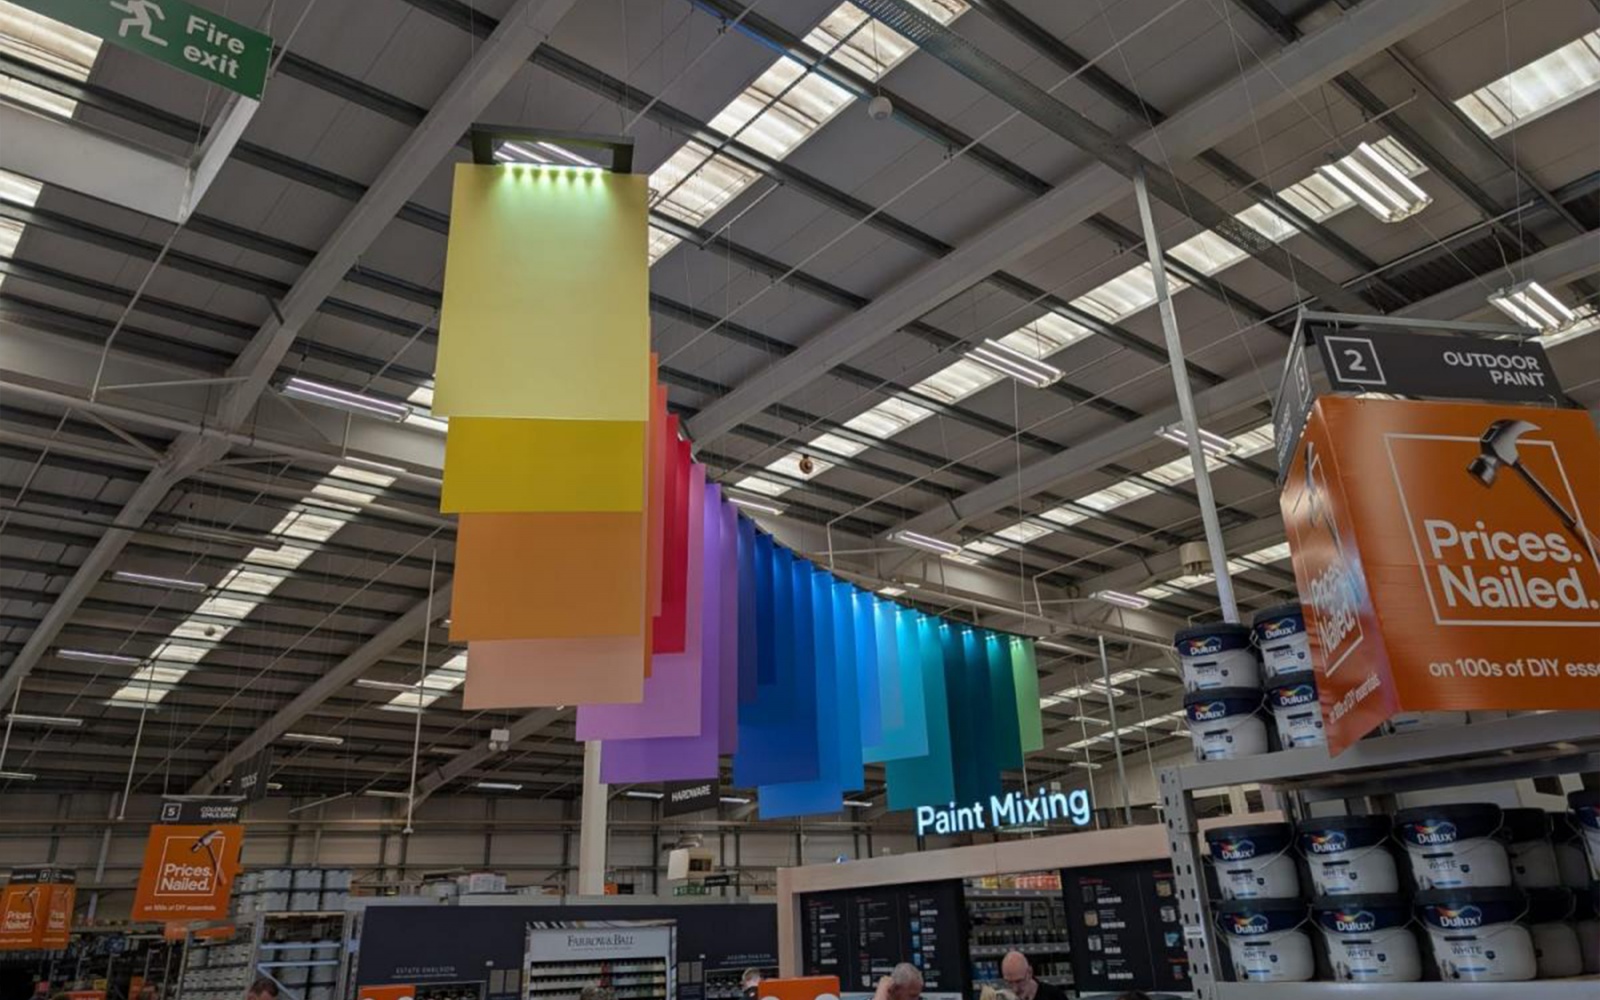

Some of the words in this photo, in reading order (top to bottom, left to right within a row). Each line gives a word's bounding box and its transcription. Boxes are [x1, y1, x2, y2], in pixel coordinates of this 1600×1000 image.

[186, 14, 245, 54] Fire
[183, 45, 240, 79] exit
[1343, 349, 1368, 371] 2
[1443, 351, 1540, 371] OUTDOOR
[1491, 370, 1545, 387] PAINT
[1423, 520, 1583, 563] Prices.
[1436, 565, 1599, 610] Nailed.
[1265, 627, 1292, 639] Dulux
[1190, 644, 1217, 655] Dulux
[1429, 661, 1454, 677] on
[1455, 658, 1503, 677] 100s
[1505, 658, 1525, 677] of
[1526, 658, 1560, 677] DIY
[1280, 694, 1309, 706] Dulux
[1195, 710, 1221, 720] Dulux
[672, 785, 711, 802] HARDWARE
[168, 807, 176, 816] 5
[916, 801, 984, 836] Paint
[989, 787, 1090, 826] Mixing
[1417, 832, 1451, 844] Dulux
[1313, 842, 1342, 852] Dulux
[1222, 849, 1250, 859] Dulux
[164, 863, 212, 877] Prices.
[1429, 860, 1458, 869] WHITE
[160, 878, 209, 891] Nailed.
[1336, 921, 1371, 931] Dulux
[1440, 915, 1477, 927] Dulux
[1234, 923, 1264, 933] Dulux
[1452, 946, 1482, 954] WHITE
